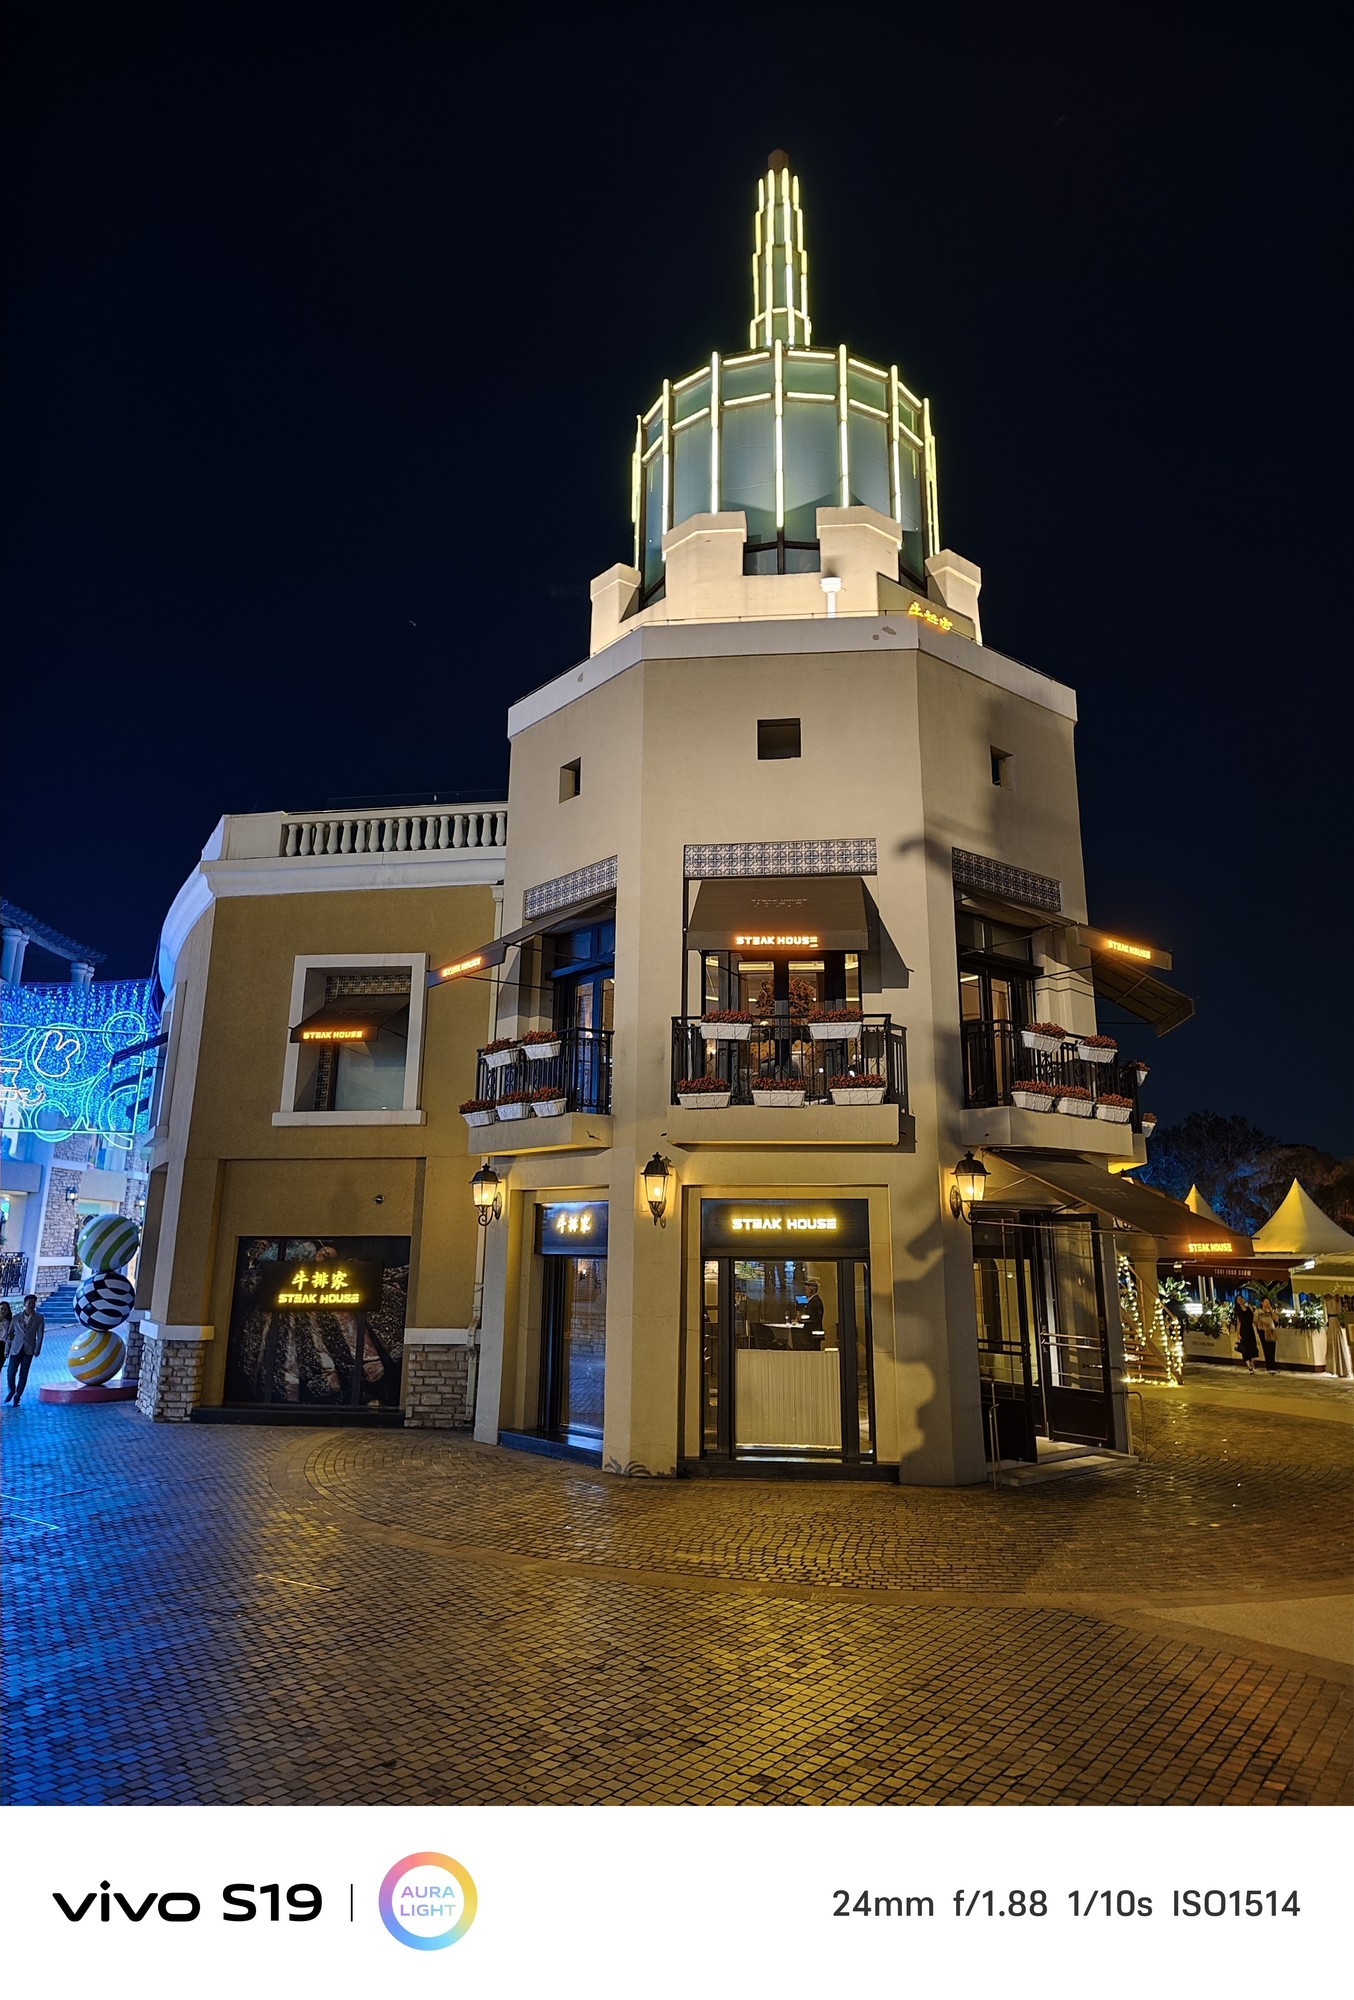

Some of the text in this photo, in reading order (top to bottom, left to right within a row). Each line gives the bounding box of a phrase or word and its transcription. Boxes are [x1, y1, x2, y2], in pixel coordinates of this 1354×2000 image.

[735, 936, 819, 948] STEAK HOUSE
[303, 1030, 363, 1039] STEAK HOUSE
[732, 1218, 837, 1230] STEAK HOUSE
[1188, 1243, 1233, 1253] STEAK HOUSE
[291, 1270, 349, 1291] 牛排家
[278, 1294, 360, 1304] STEAK HOUSE
